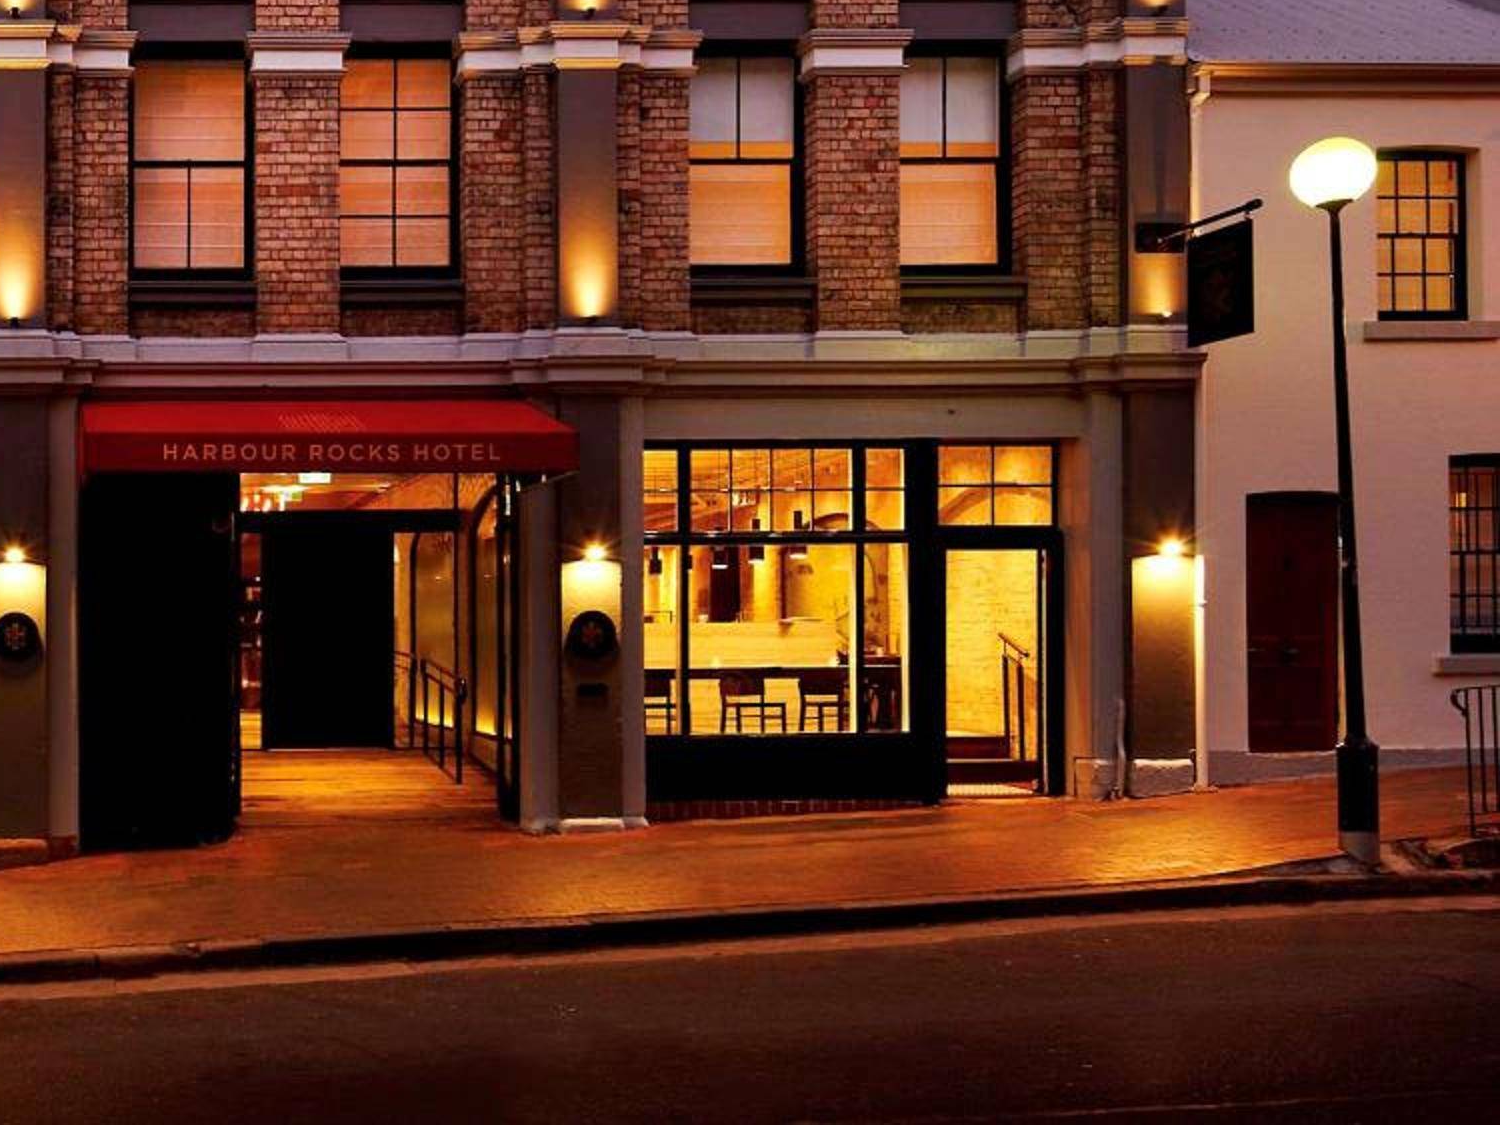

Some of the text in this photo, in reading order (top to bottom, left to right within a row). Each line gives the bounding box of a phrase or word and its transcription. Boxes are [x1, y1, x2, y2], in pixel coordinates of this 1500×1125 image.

[162, 443, 501, 462] HARBOUR ROCKS HOTEL
